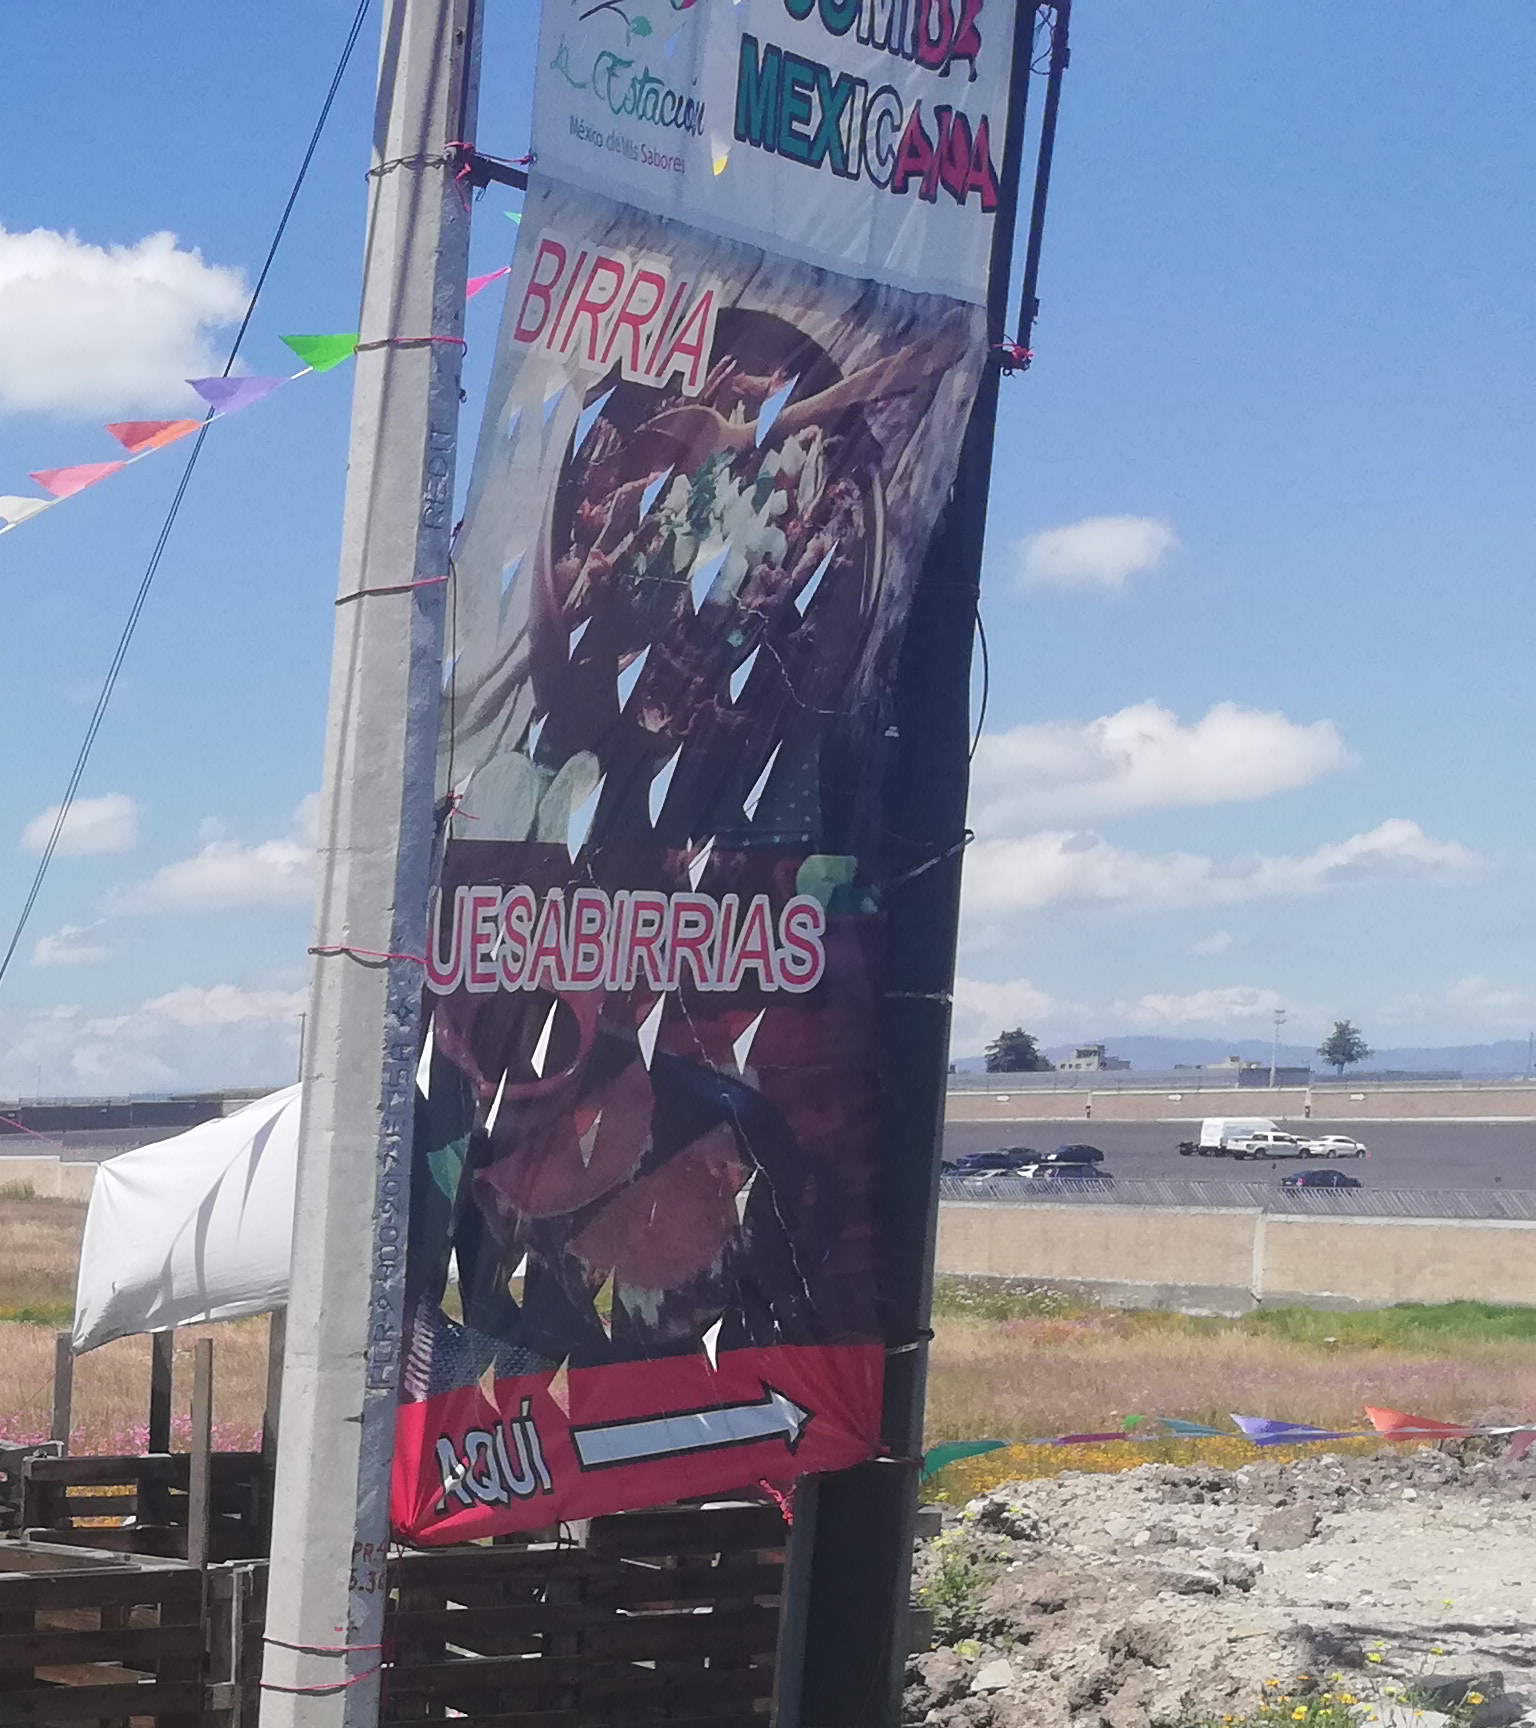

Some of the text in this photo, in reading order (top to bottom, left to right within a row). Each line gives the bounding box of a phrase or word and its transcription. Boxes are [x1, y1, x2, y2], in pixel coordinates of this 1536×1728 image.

[783, 0, 984, 82] IDA
[569, 115, 603, 147] México
[641, 143, 686, 173] Sabores
[733, 33, 1000, 213] MEXICANA
[511, 234, 717, 390] BIRRIA
[435, 1395, 554, 1514] AQUÍ
